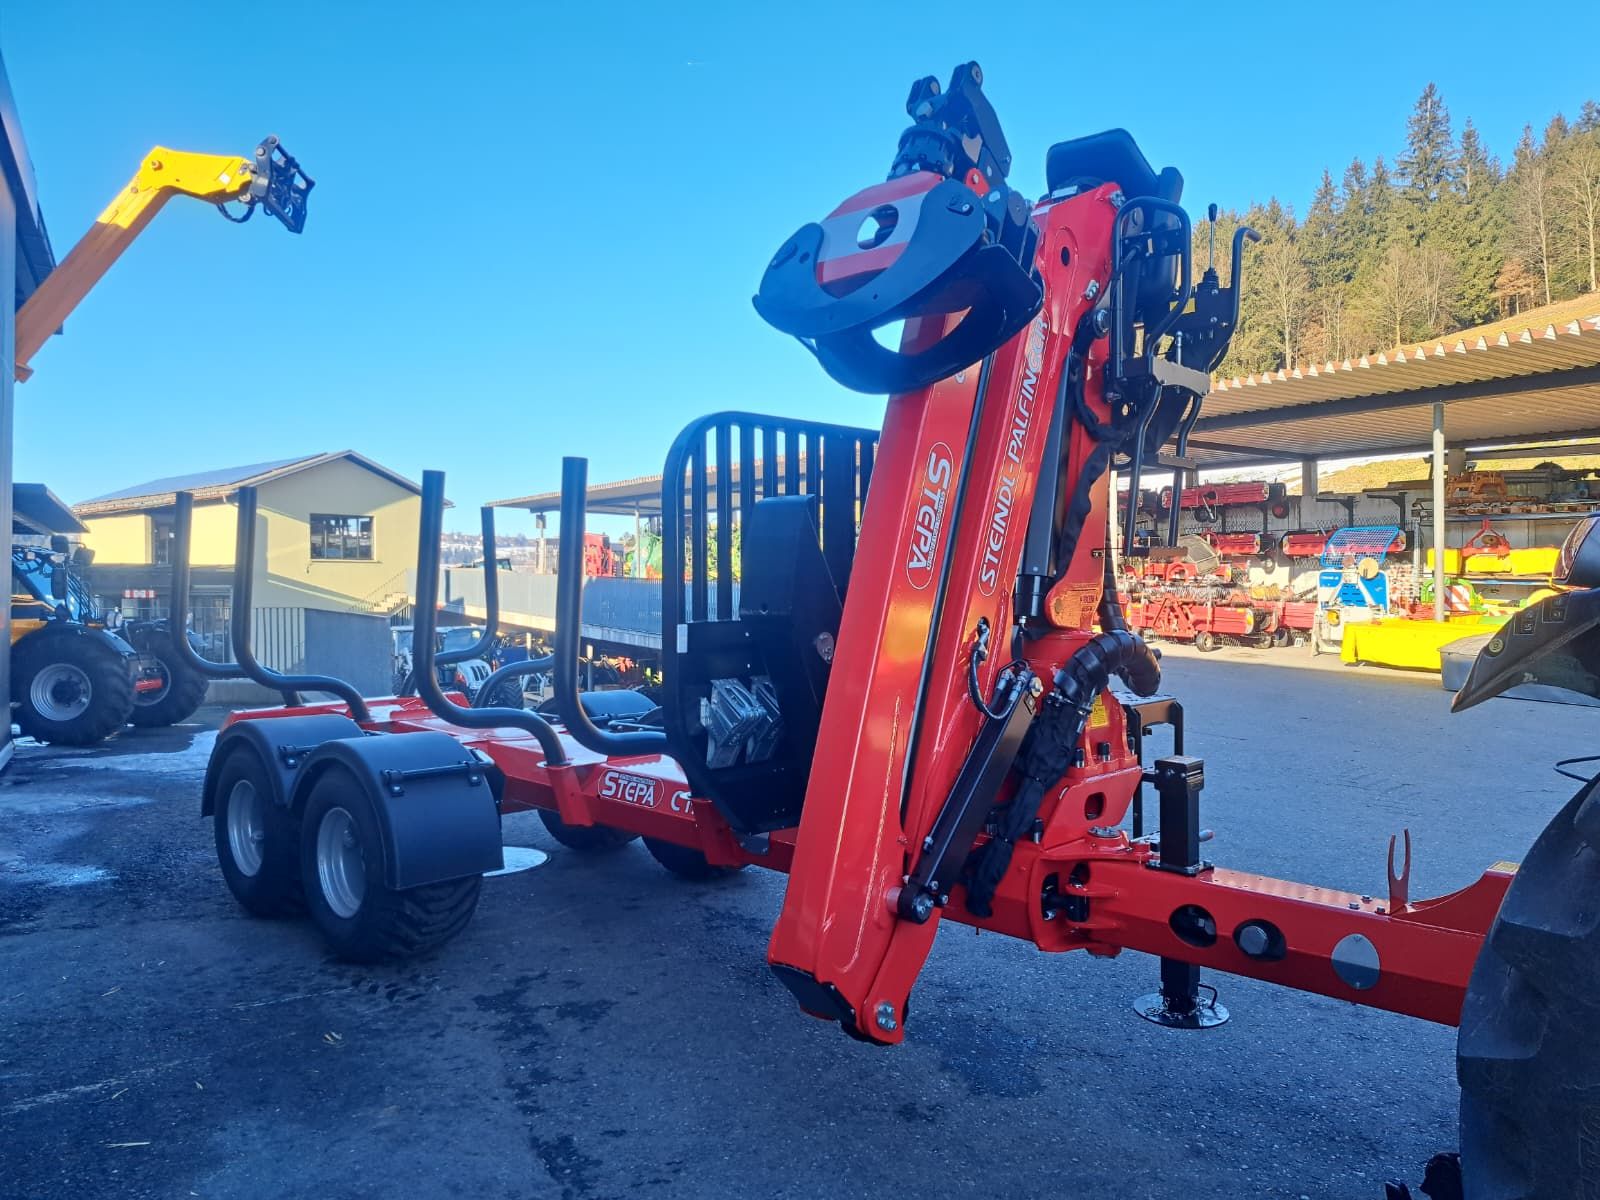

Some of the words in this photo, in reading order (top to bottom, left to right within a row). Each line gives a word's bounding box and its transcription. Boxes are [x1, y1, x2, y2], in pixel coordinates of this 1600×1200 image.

[908, 452, 951, 571] STEPA
[981, 475, 1017, 587] STEINDL
[1007, 318, 1049, 464] PALFINGER
[602, 771, 655, 806] STEPA
